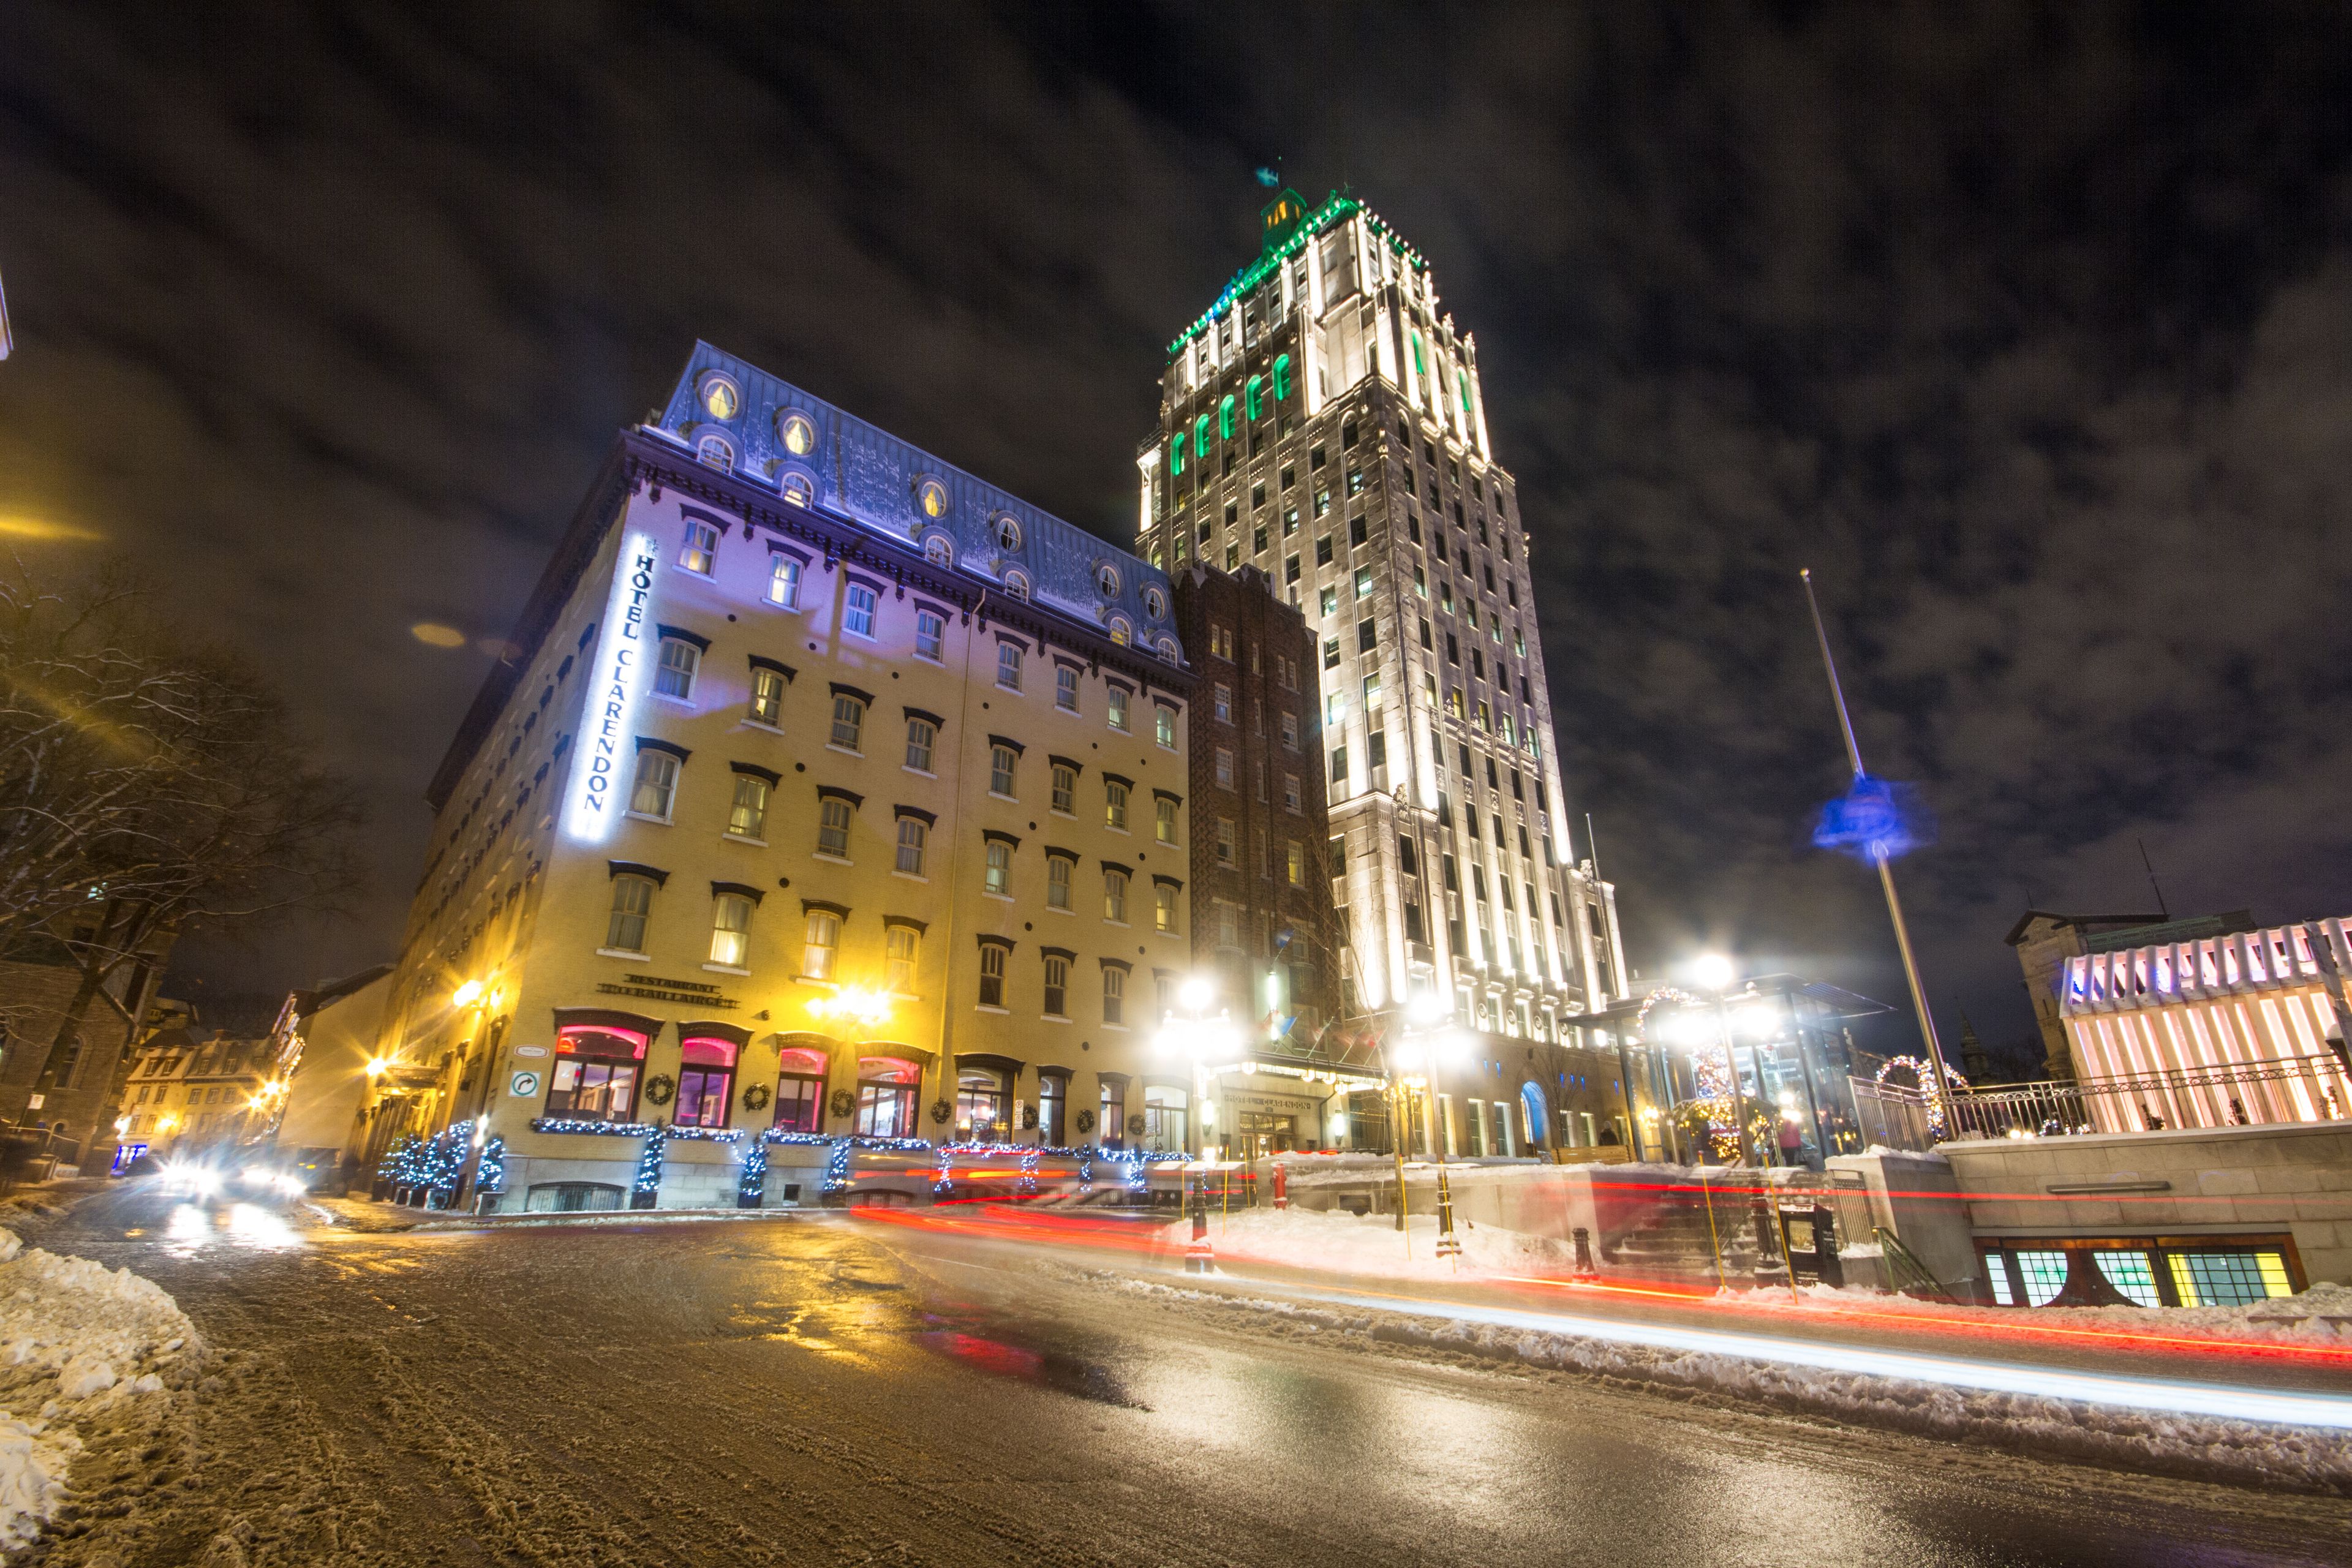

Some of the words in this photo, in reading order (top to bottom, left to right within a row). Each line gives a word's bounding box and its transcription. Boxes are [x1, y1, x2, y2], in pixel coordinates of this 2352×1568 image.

[622, 554, 655, 640] HÔTEL
[584, 649, 633, 812] CLARENDON
[630, 975, 715, 993] RESTAURANT
[1263, 1098, 1308, 1110] CLARENDON
